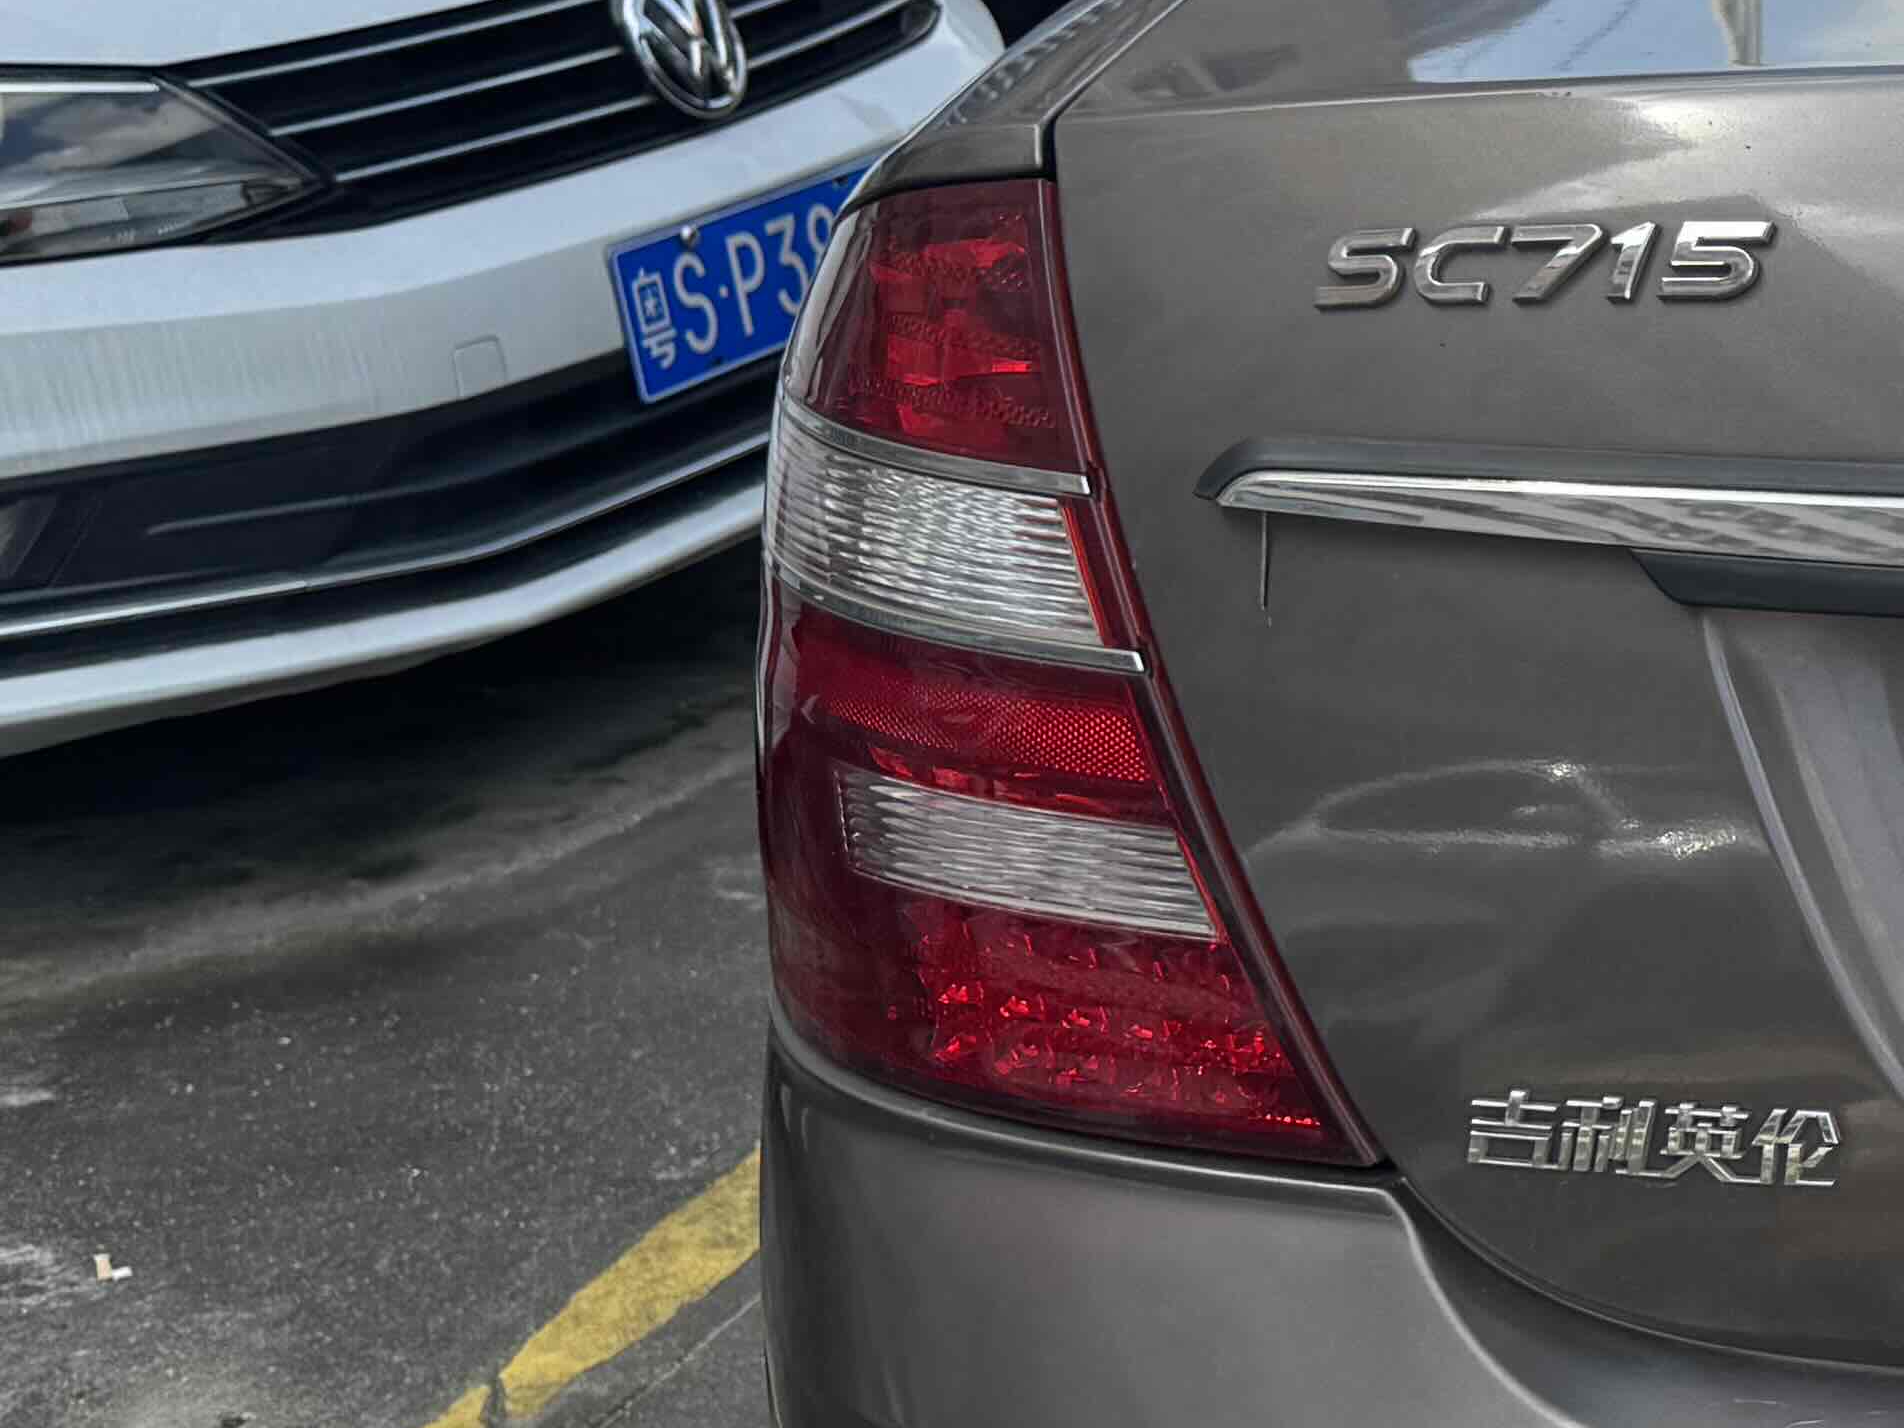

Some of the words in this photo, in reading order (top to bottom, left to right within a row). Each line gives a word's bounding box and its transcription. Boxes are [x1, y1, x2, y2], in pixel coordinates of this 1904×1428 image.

[1313, 220, 1778, 312] SC715
[1466, 1088, 1842, 1186] 吉利英伦
